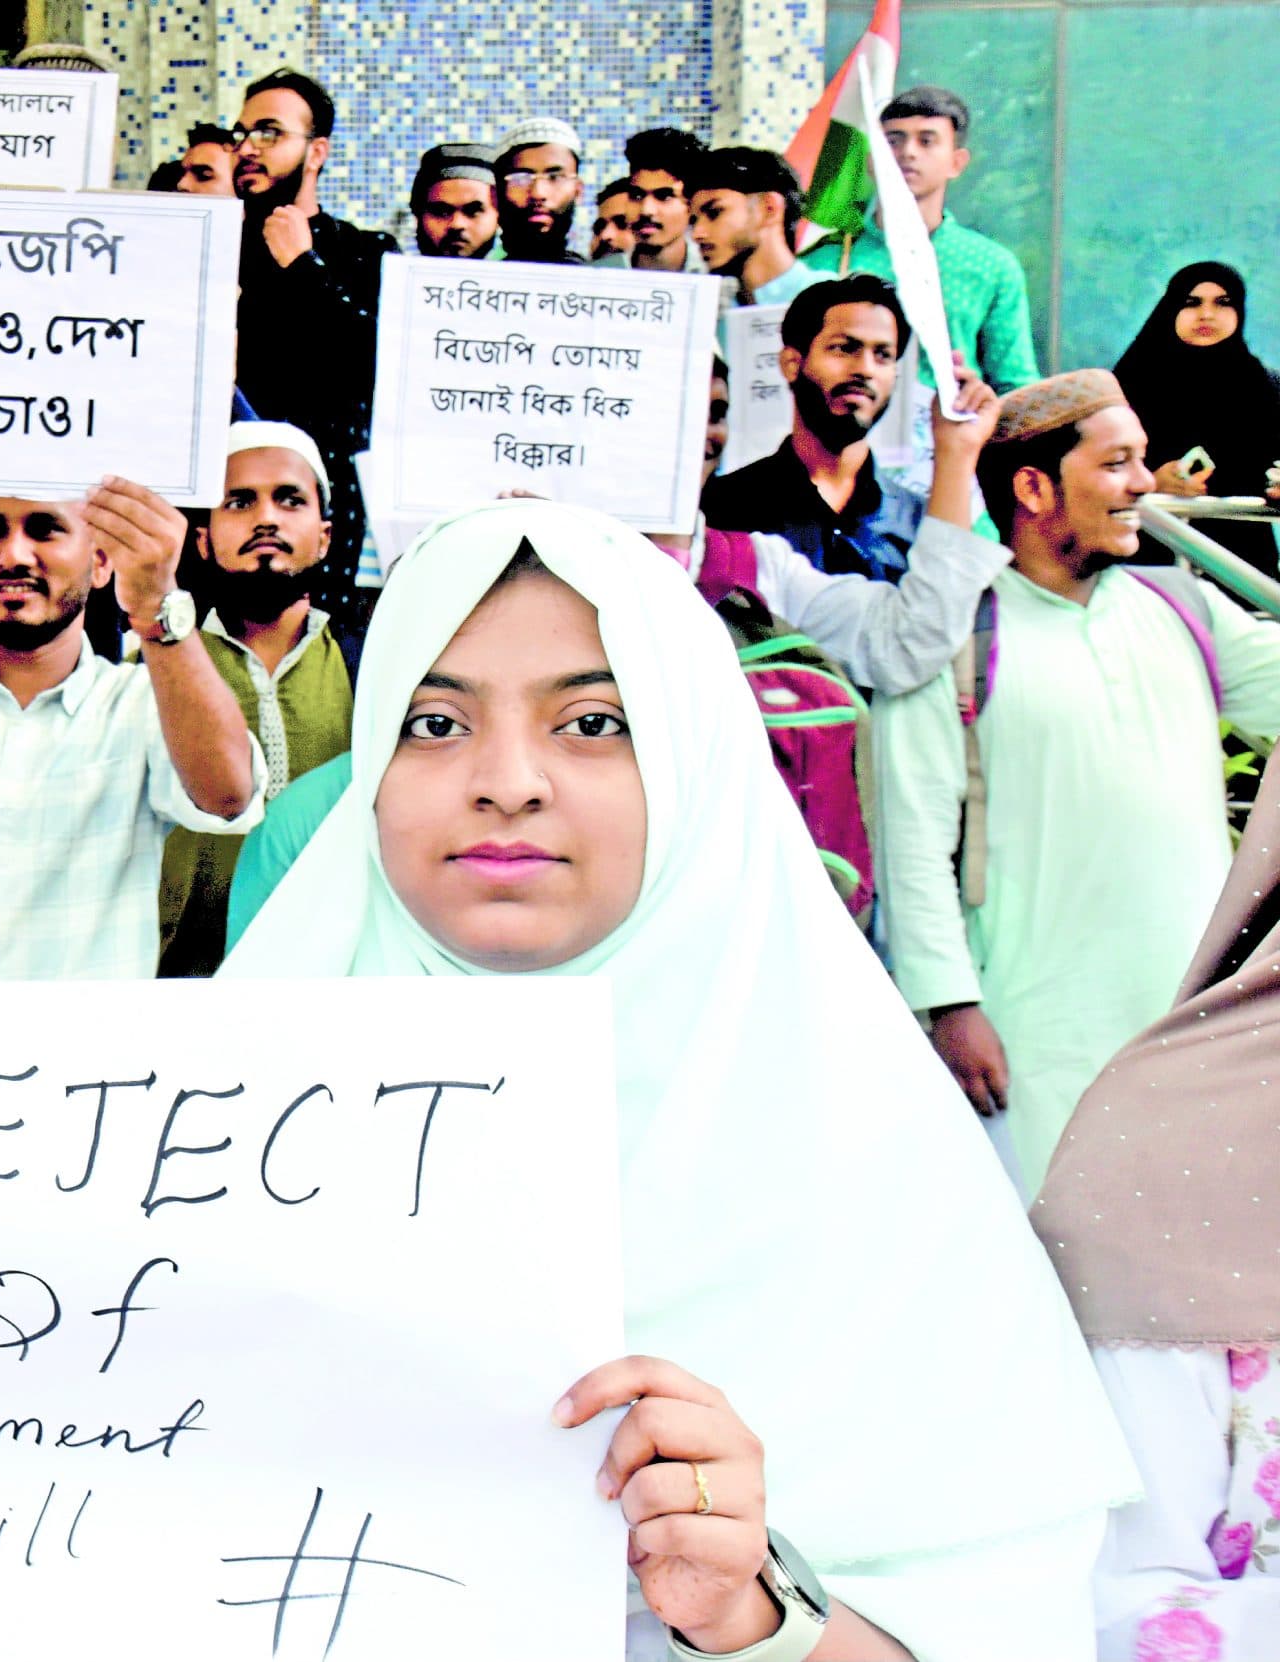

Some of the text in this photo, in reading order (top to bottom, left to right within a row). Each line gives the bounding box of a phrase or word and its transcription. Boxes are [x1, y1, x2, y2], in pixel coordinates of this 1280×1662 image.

[423, 280, 530, 313] সংবিধান
[434, 329, 642, 370] বিজেপি তোমায়
[430, 384, 633, 419] জানাই ধিক ধিক
